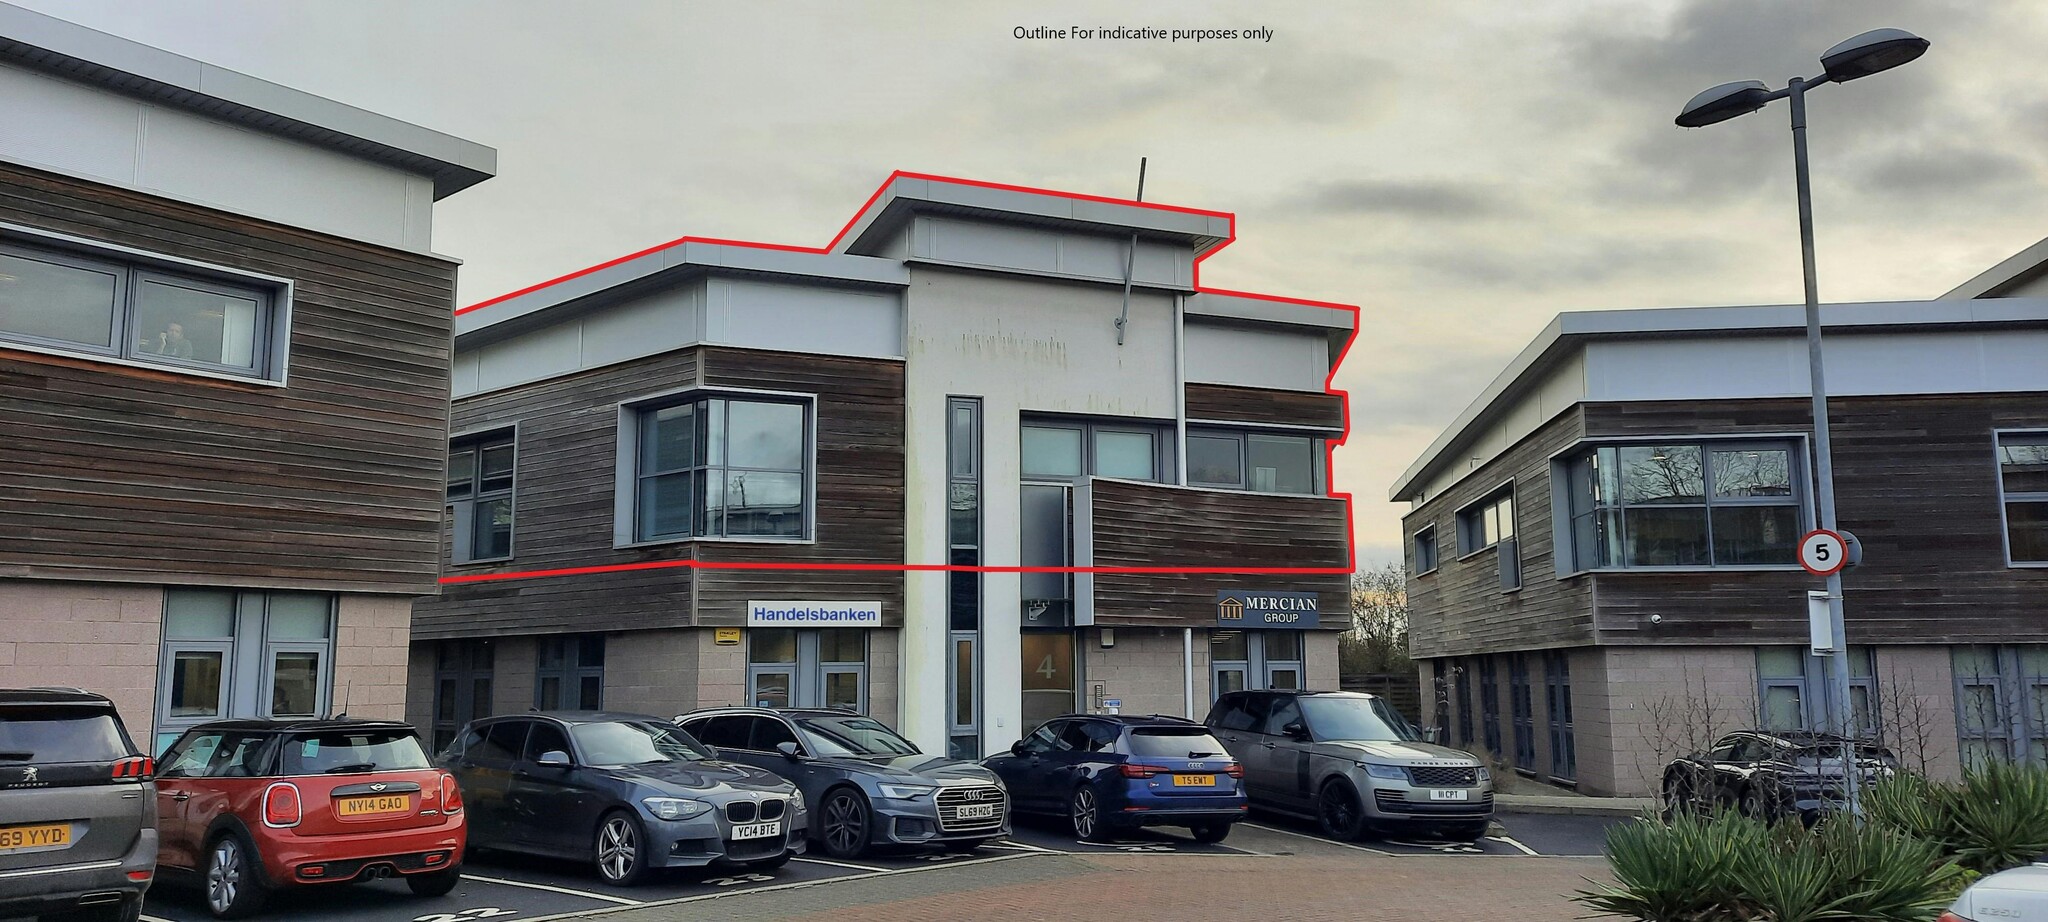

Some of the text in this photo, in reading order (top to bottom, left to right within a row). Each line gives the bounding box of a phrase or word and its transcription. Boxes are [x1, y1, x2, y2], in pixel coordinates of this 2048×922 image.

[1815, 543, 1830, 561] 5
[1245, 596, 1317, 611] MERCIAN
[754, 607, 876, 621] Handelsbanken
[1264, 613, 1299, 623] GROUP
[1035, 654, 1057, 679] 4
[1445, 790, 1459, 799] CPT
[348, 799, 376, 812] NY14
[959, 807, 978, 818] SL69
[0, 828, 62, 847] 69 YYD
[738, 823, 776, 838] YC14 BTE
